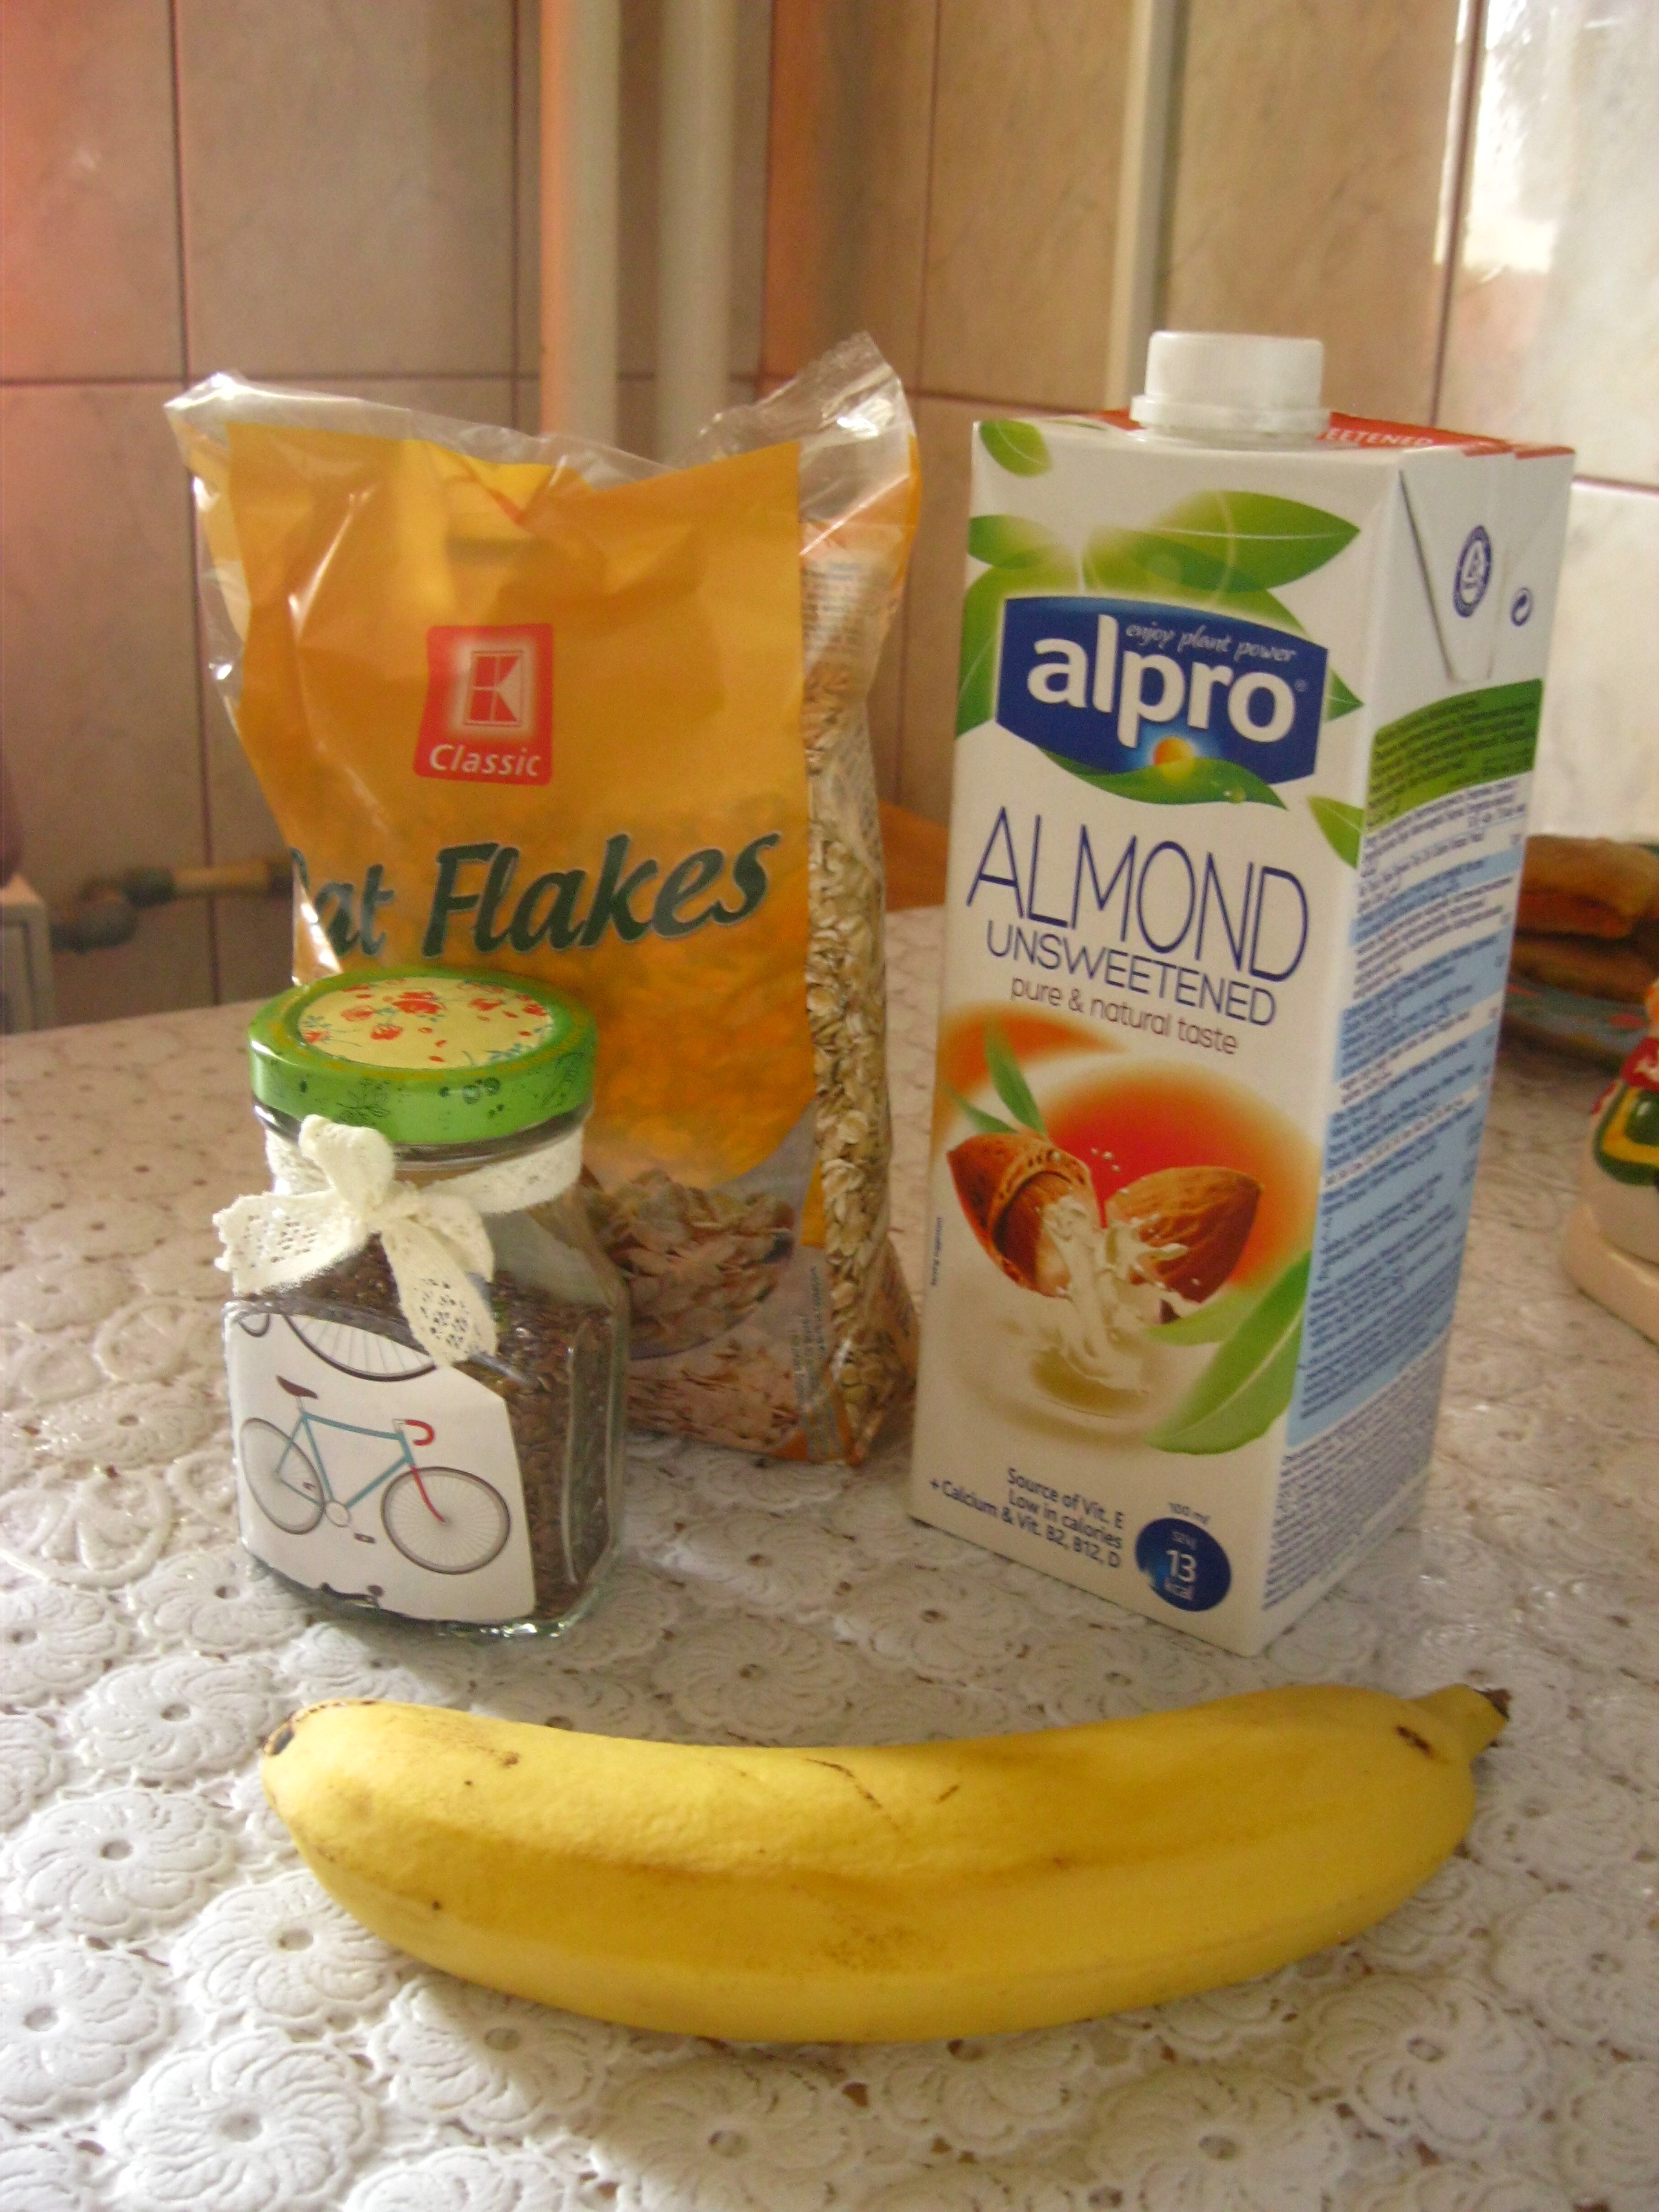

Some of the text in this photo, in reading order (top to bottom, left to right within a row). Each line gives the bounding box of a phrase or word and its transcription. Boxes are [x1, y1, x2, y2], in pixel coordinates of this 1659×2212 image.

[1027, 614, 1295, 748] alpro
[1125, 621, 1296, 662] enjoy plant power
[428, 743, 541, 778] Classic
[421, 831, 782, 957] Flakes
[967, 806, 1309, 982] ALMOND
[987, 920, 1276, 1027] UNSWEETENED
[1011, 976, 1238, 1055] pure & natural taste
[942, 1480, 998, 1516] Calcium
[1002, 1506, 1013, 1524] &
[1108, 1550, 1121, 1568] D
[1008, 1467, 1059, 1503] Source
[1062, 1493, 1079, 1509] of
[1114, 1511, 1125, 1529] E
[1008, 1489, 1122, 1549] Low in calories
[1166, 1550, 1197, 1583] 13
